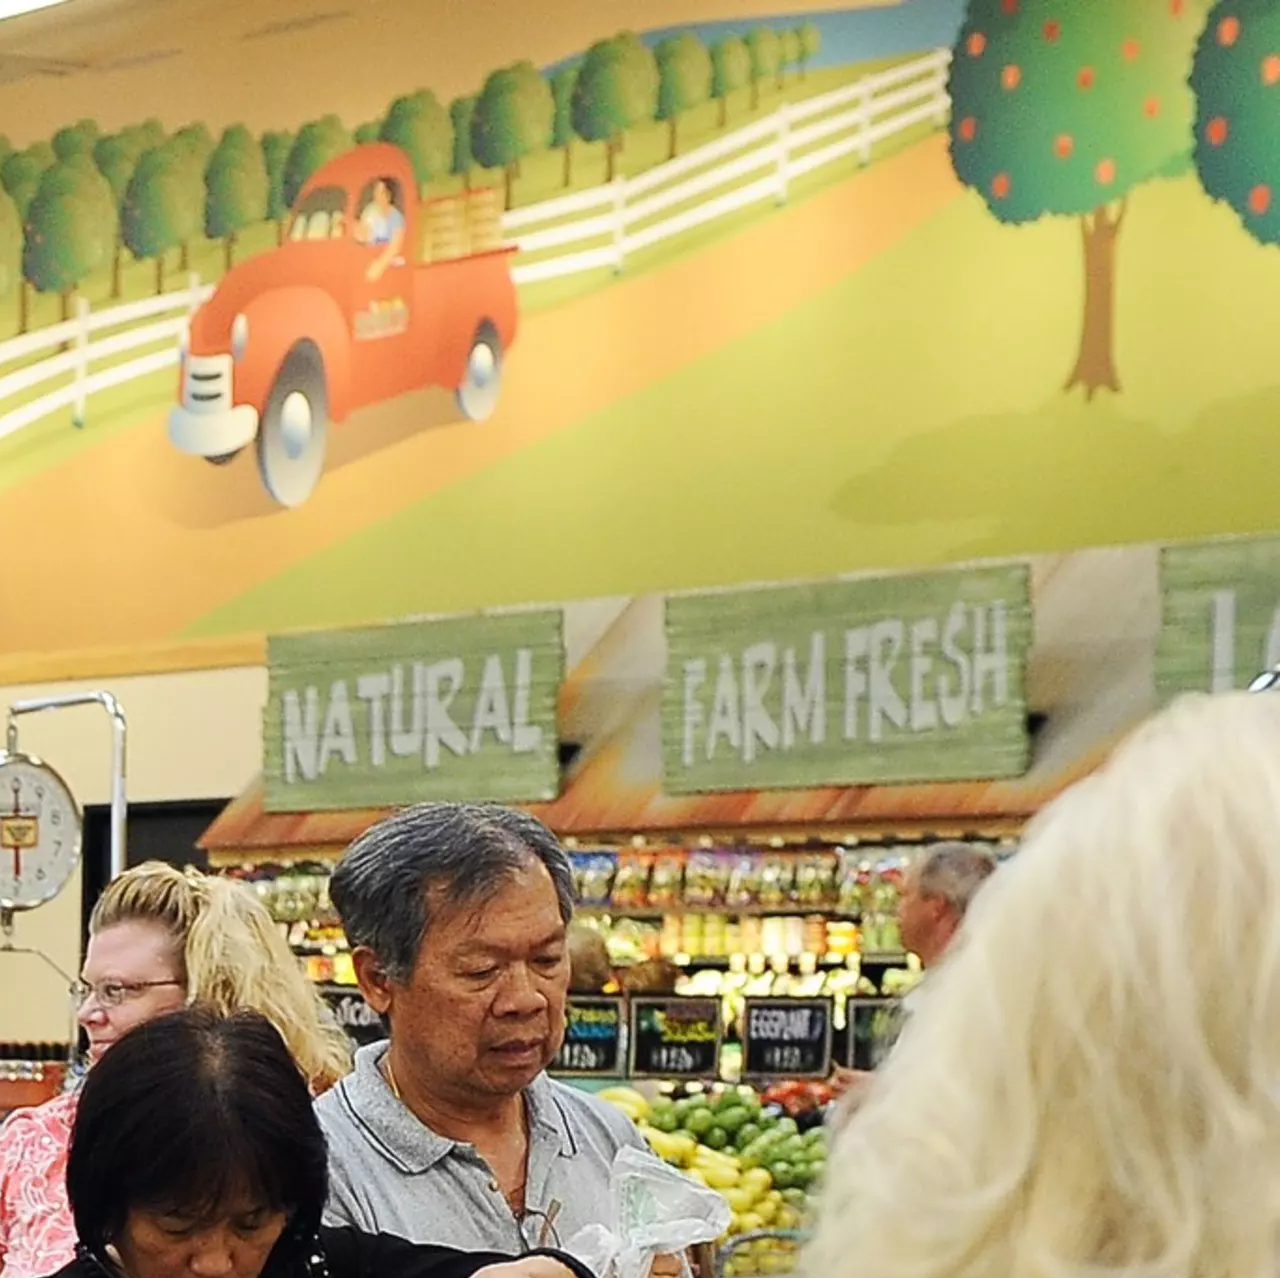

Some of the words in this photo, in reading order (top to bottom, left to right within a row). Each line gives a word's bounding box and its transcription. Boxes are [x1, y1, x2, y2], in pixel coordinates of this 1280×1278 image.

[282, 649, 542, 785] NATURAL
[682, 630, 827, 769] FARM
[844, 599, 1009, 744] FRESH
